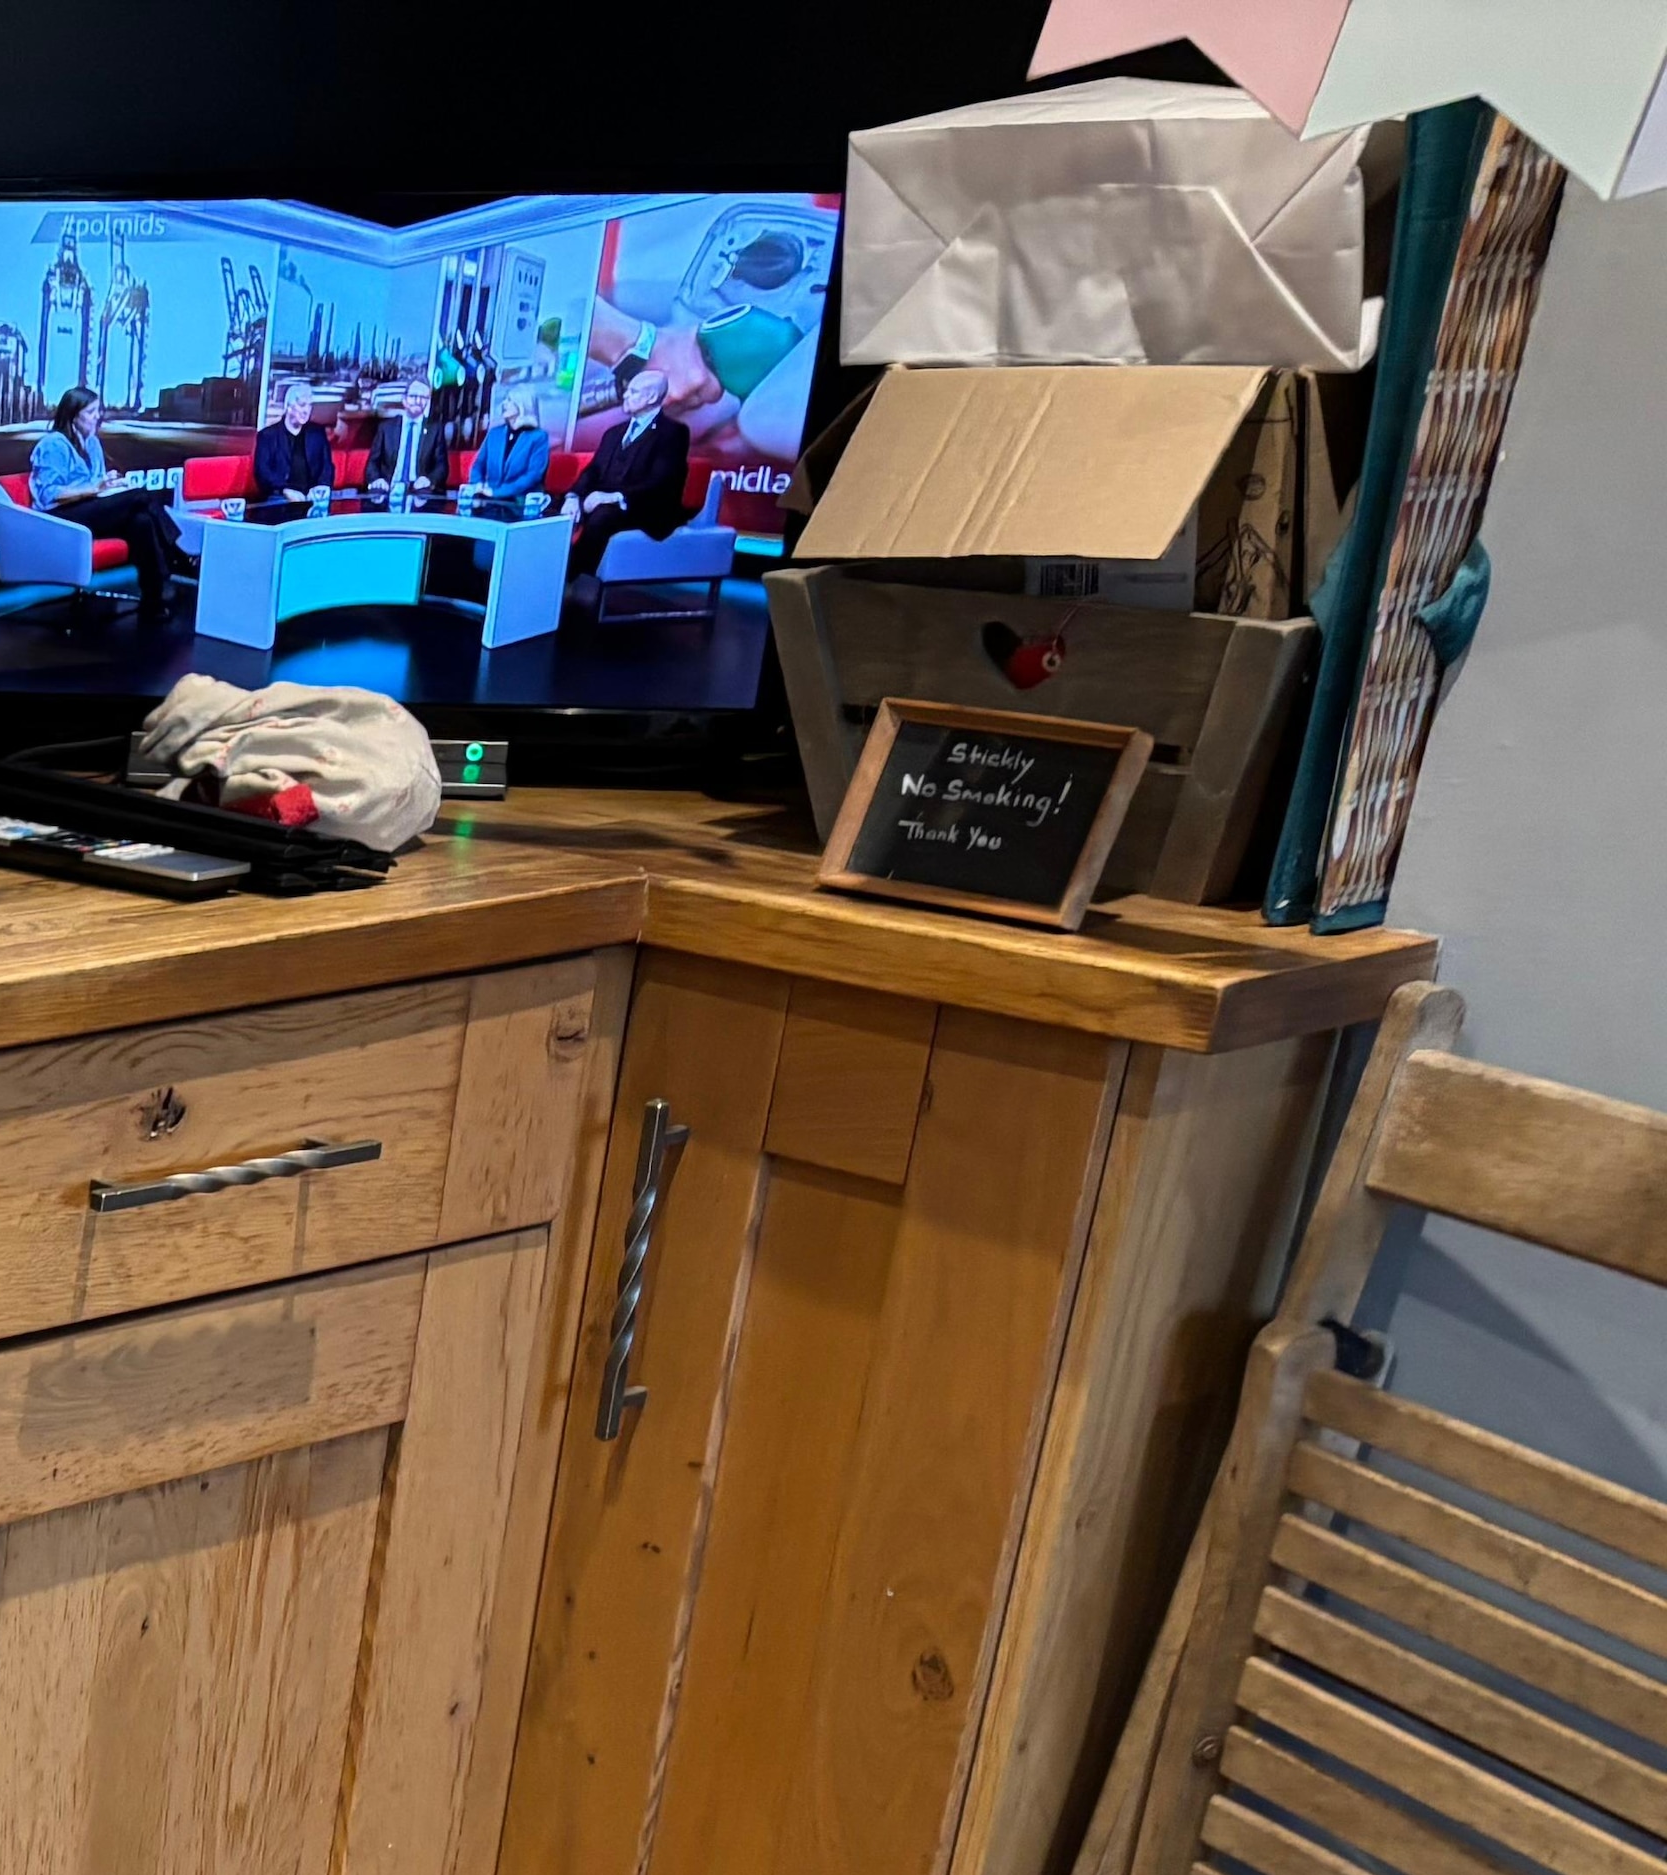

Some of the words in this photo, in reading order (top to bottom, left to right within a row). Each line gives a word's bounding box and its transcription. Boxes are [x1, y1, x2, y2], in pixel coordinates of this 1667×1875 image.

[901, 773, 937, 797] No
[942, 773, 1074, 828] Smoking!
[898, 812, 960, 844] Thank
